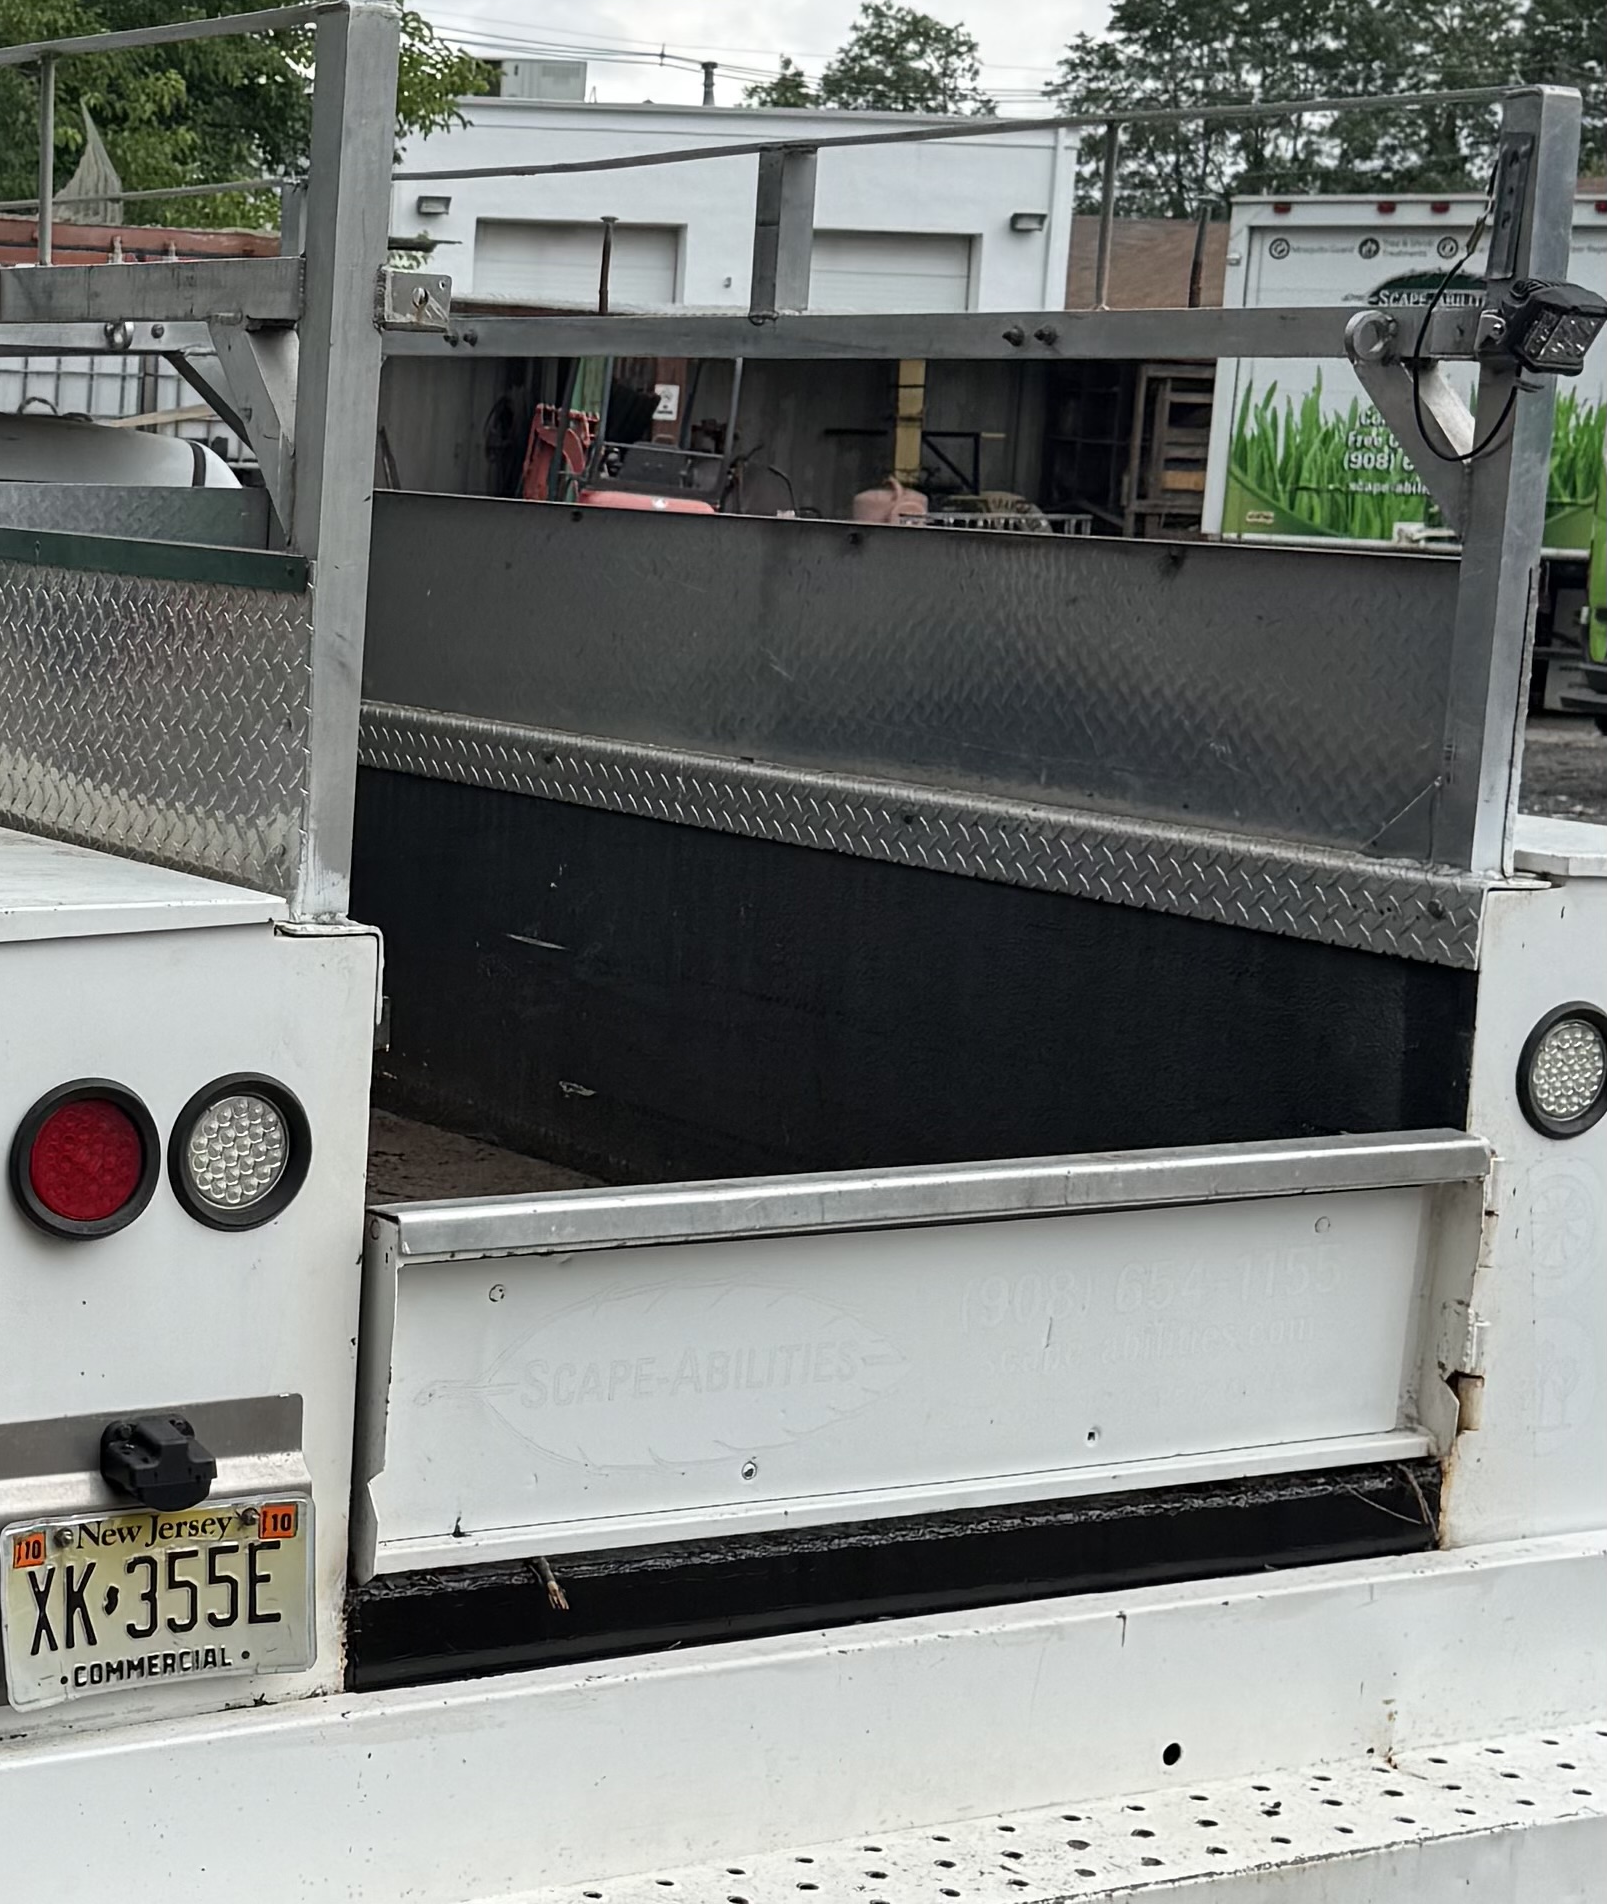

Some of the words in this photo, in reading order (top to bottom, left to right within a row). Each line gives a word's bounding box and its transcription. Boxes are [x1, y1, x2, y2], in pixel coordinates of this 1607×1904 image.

[1343, 450, 1395, 472] (908)
[960, 1268, 1093, 1336] (908)
[1113, 1241, 1344, 1316] 654-1155
[519, 1338, 861, 1411] SCAPE-ABILITIES
[76, 1522, 143, 1550] New
[145, 1511, 234, 1547] Jersey
[74, 1646, 233, 1688] COMMERCIAL
